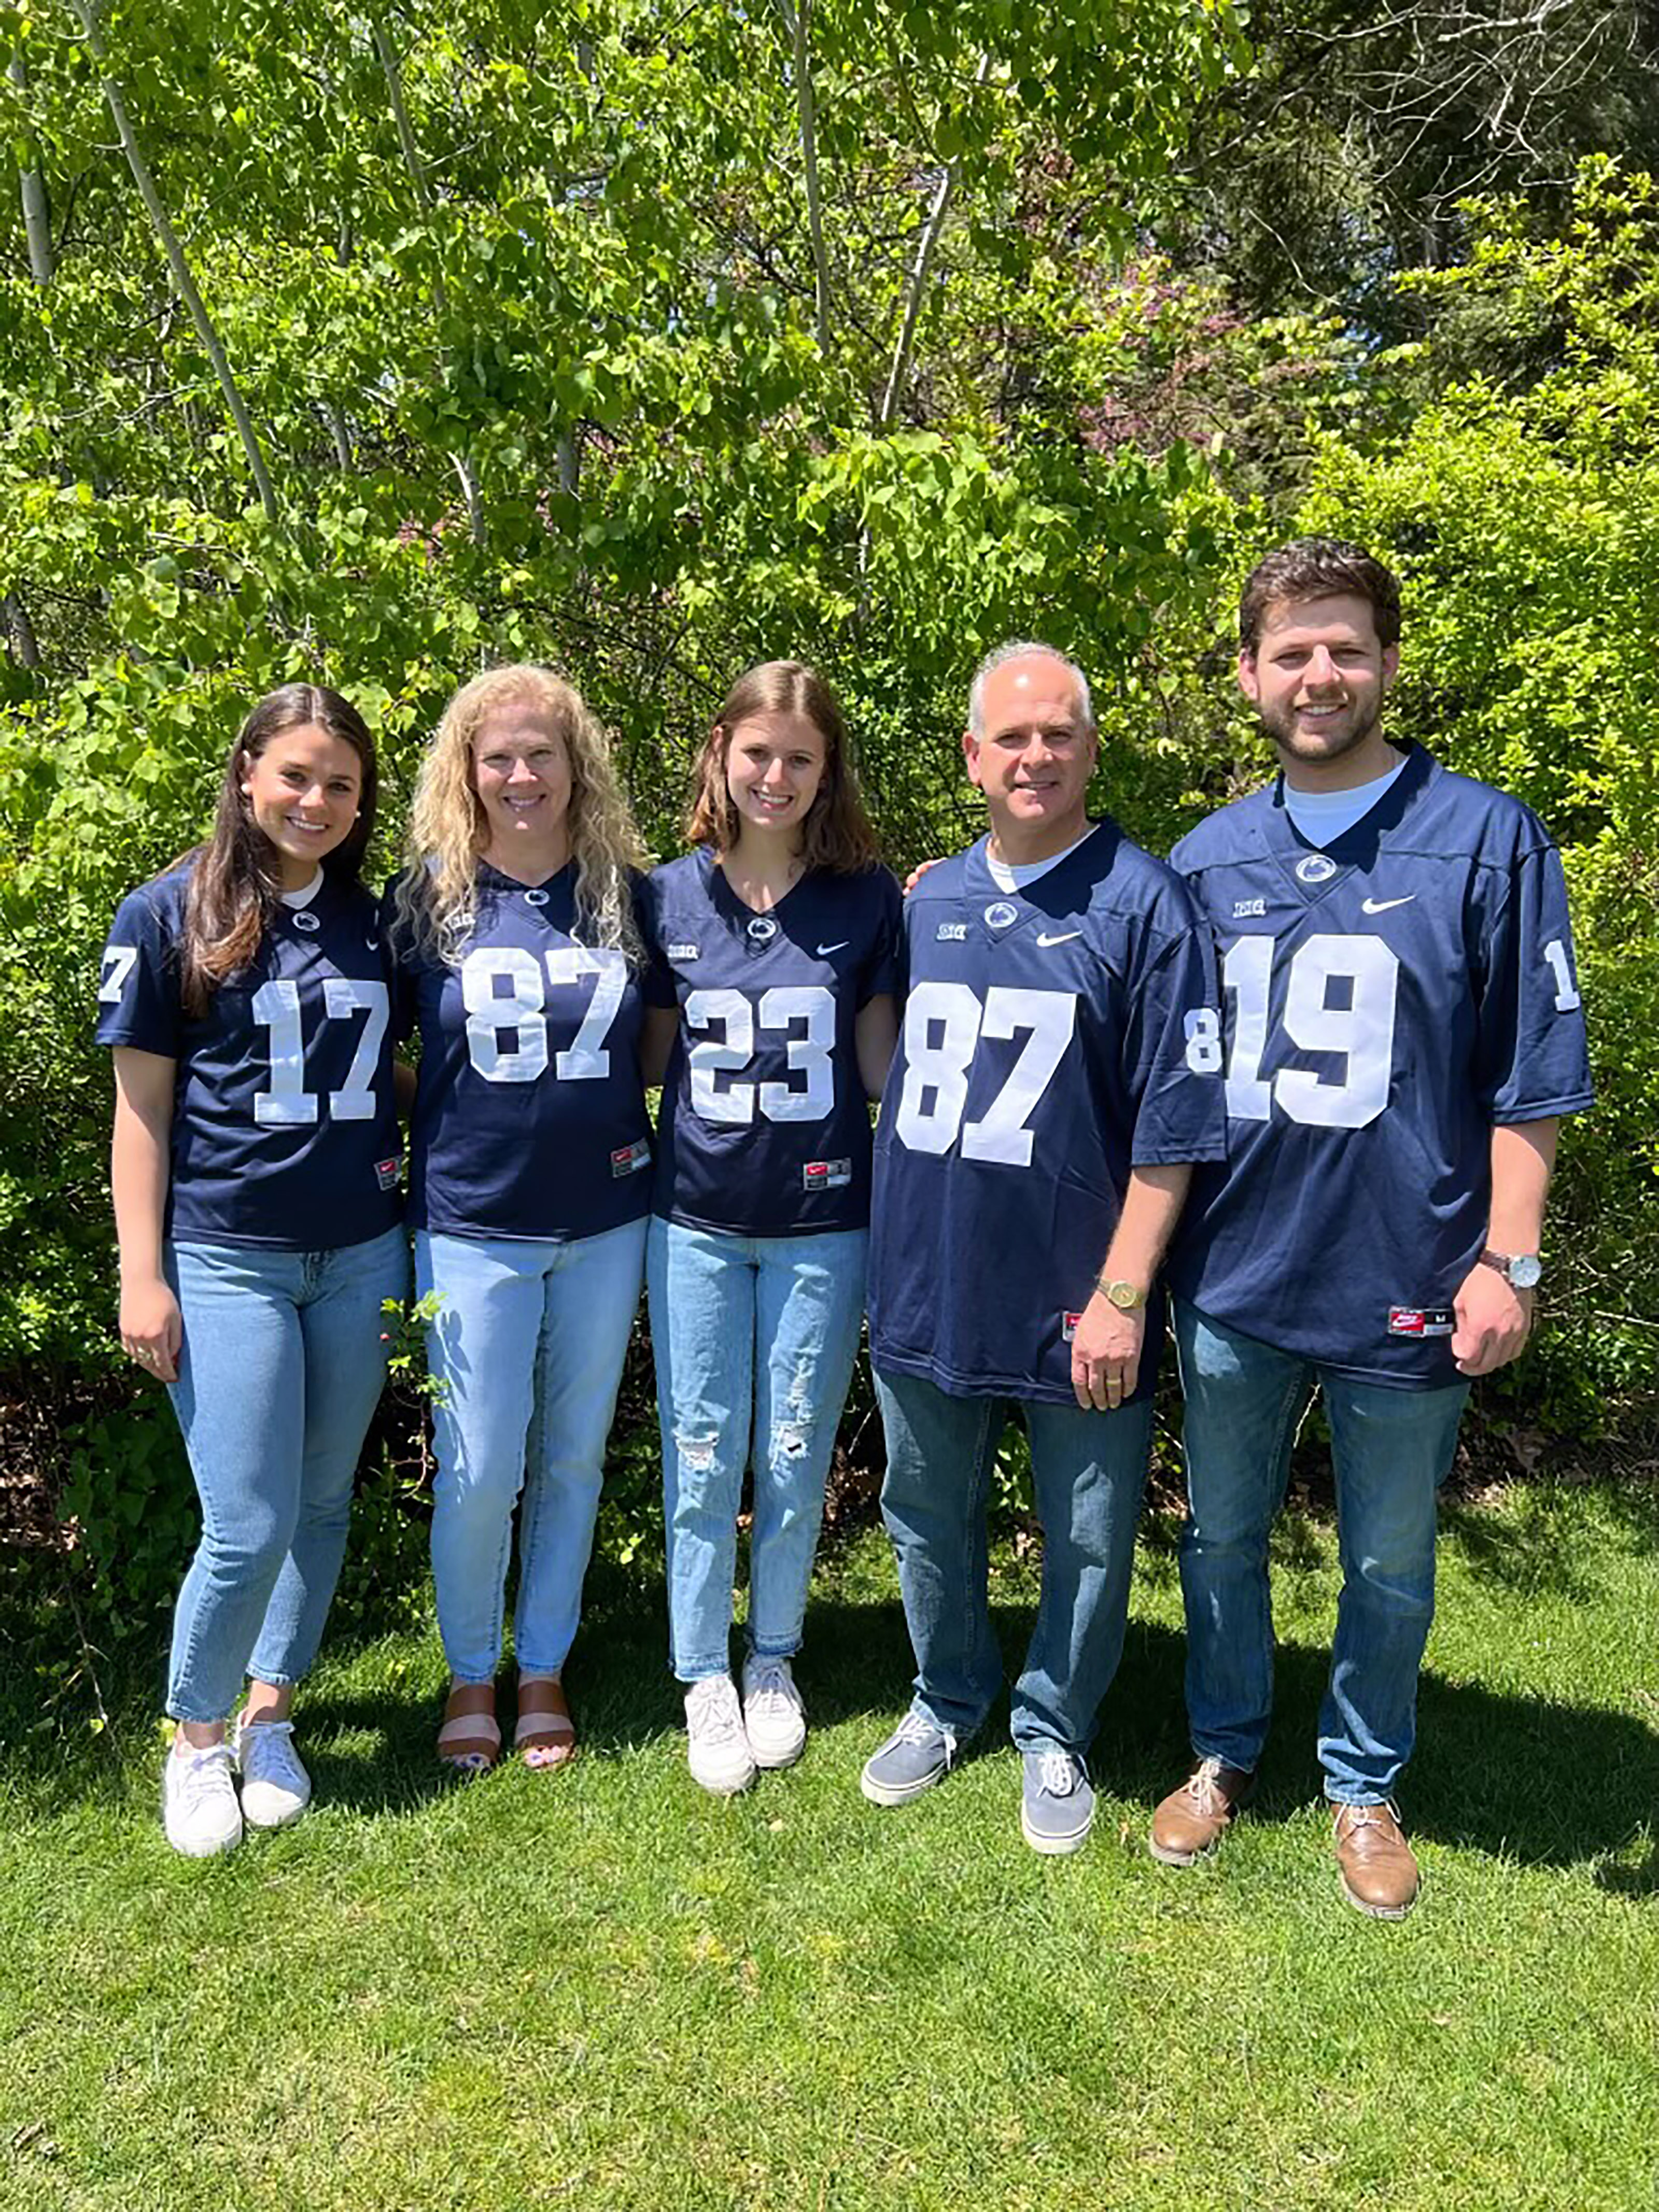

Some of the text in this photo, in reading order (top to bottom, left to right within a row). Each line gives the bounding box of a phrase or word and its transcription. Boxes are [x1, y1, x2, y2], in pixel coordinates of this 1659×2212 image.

[98, 945, 137, 1003] 7
[462, 948, 627, 1082] 87
[1184, 1008, 1222, 1073] 8
[1224, 935, 1399, 1129] 19
[1544, 939, 1580, 1011] 1
[252, 979, 390, 1123] 17
[685, 986, 836, 1123] 23
[895, 981, 1077, 1167] 87
